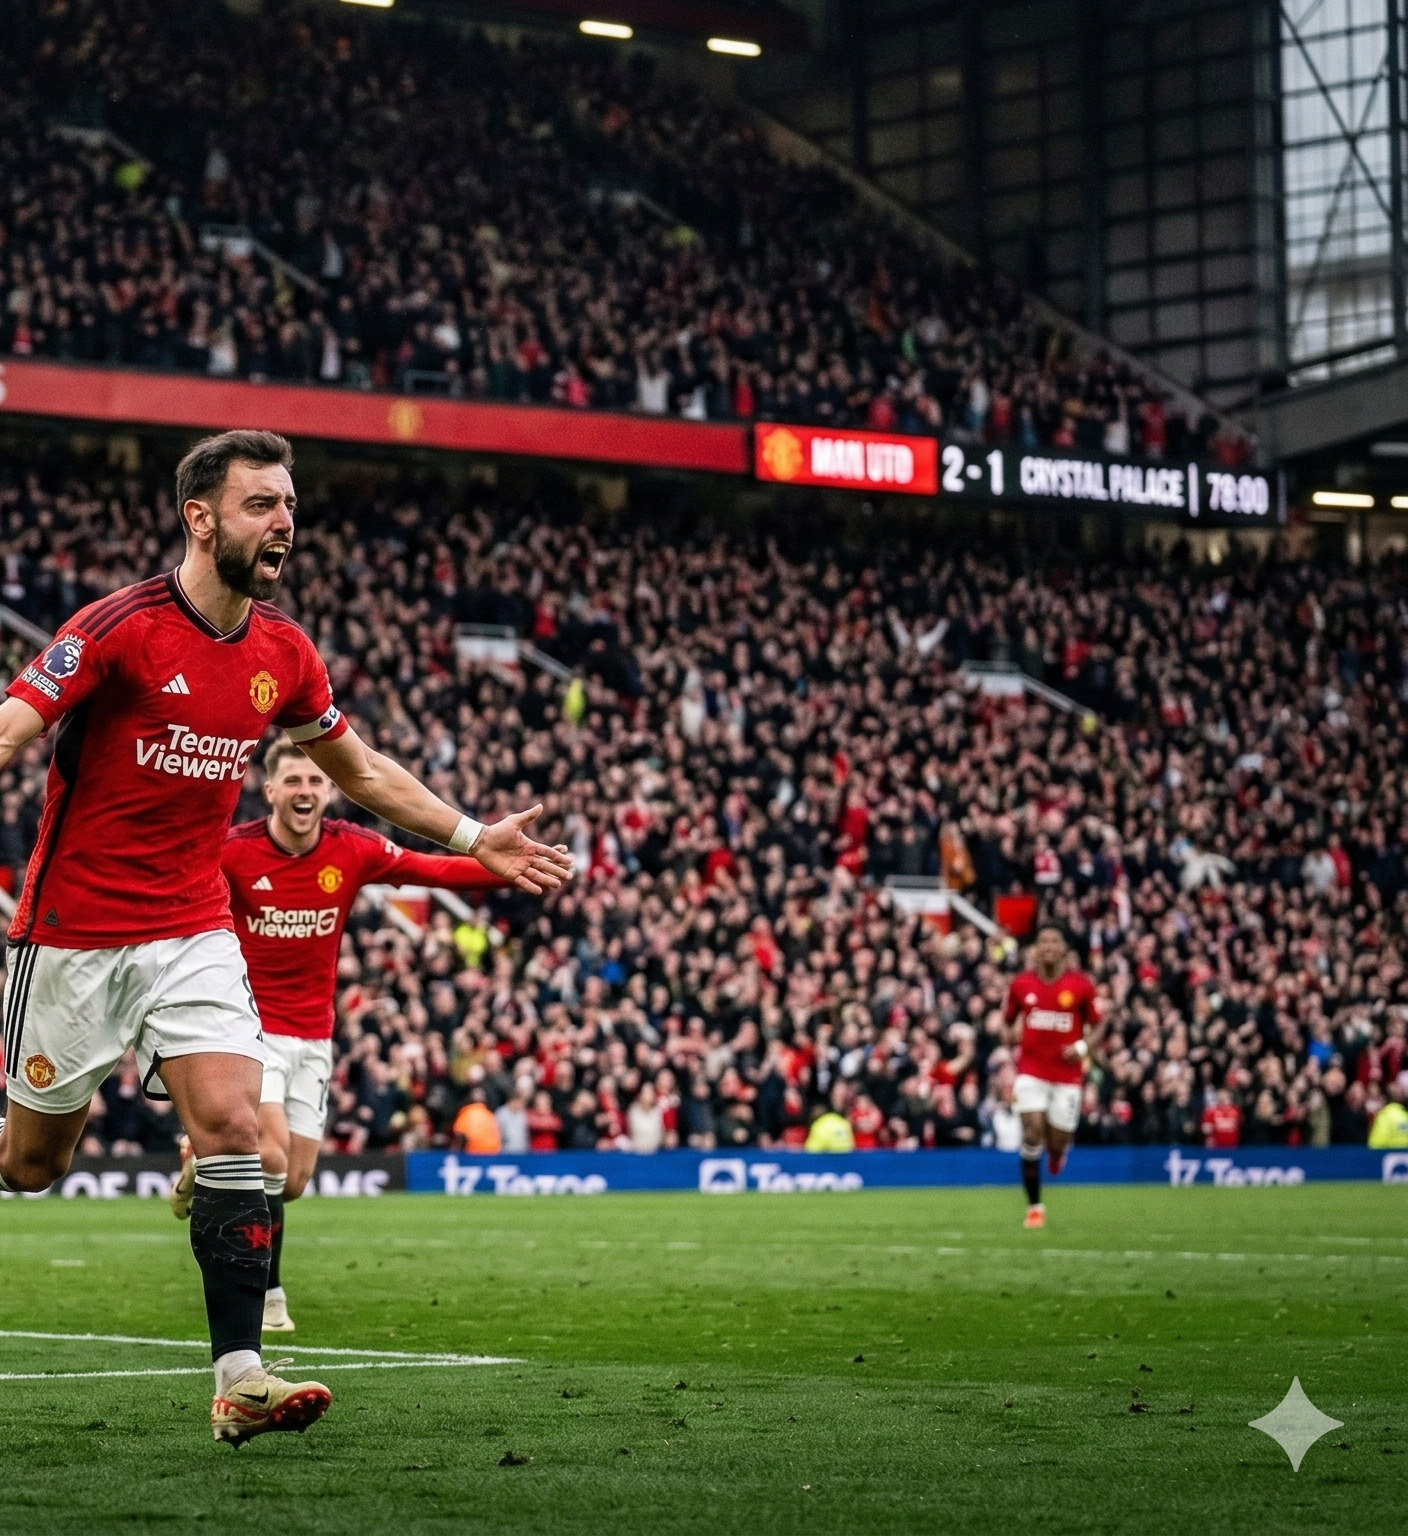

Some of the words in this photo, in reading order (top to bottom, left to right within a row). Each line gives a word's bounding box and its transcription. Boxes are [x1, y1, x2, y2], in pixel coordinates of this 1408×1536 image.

[1020, 456, 1109, 501] CRYSTAL
[1109, 464, 1185, 507] PALACE
[136, 738, 233, 780] Viewer
[168, 723, 239, 759] Team
[246, 915, 316, 938] Viewer
[260, 906, 316, 924] Team
